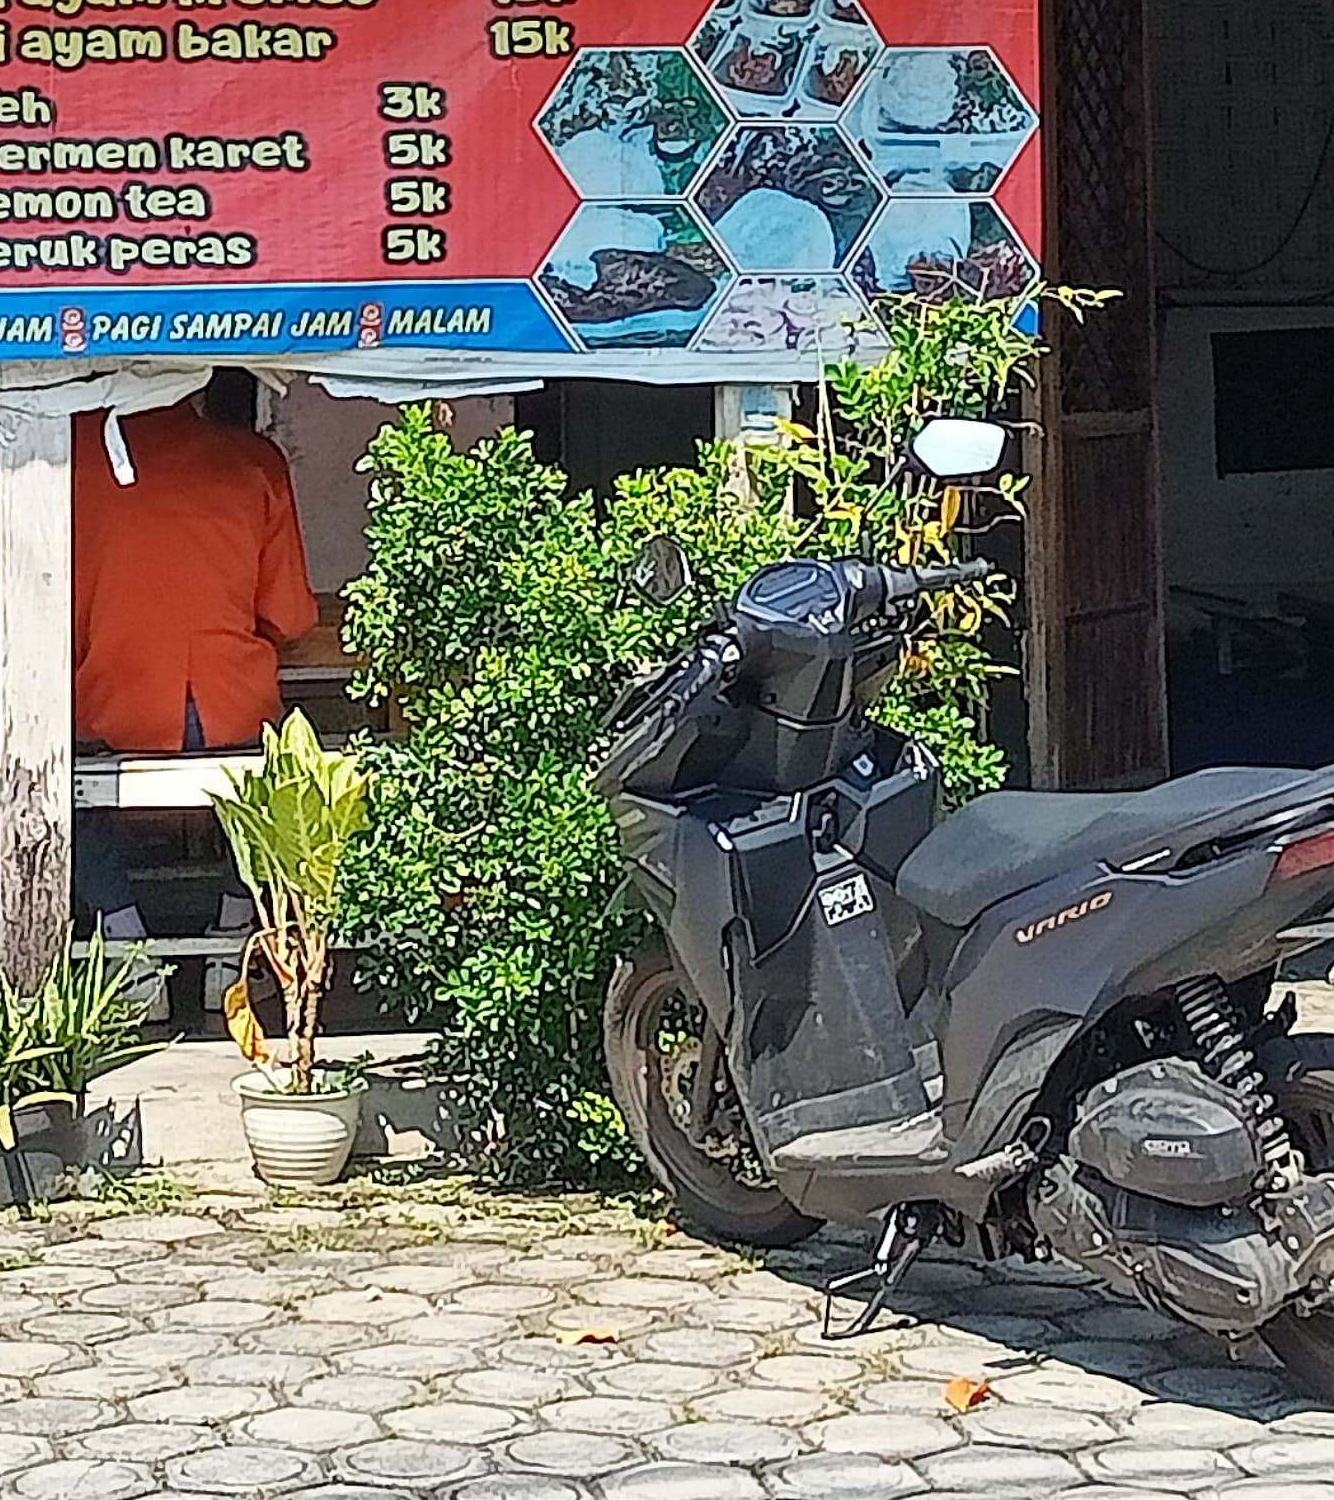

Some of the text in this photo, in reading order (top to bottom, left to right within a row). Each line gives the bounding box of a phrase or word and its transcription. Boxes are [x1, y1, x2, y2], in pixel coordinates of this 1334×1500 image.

[18, 29, 162, 66] ayam
[178, 24, 333, 60] bakar
[489, 20, 572, 56] 15k
[381, 85, 443, 118] 3k
[170, 132, 306, 171] karet
[386, 133, 449, 166] 5k
[125, 184, 207, 218] tea
[389, 181, 449, 213] 5k
[111, 232, 252, 271] peras
[385, 228, 444, 262] 5k
[92, 314, 161, 342] PAGI
[169, 310, 279, 341] SAMPAI
[291, 310, 352, 336] JAM
[388, 307, 491, 334] MALAM
